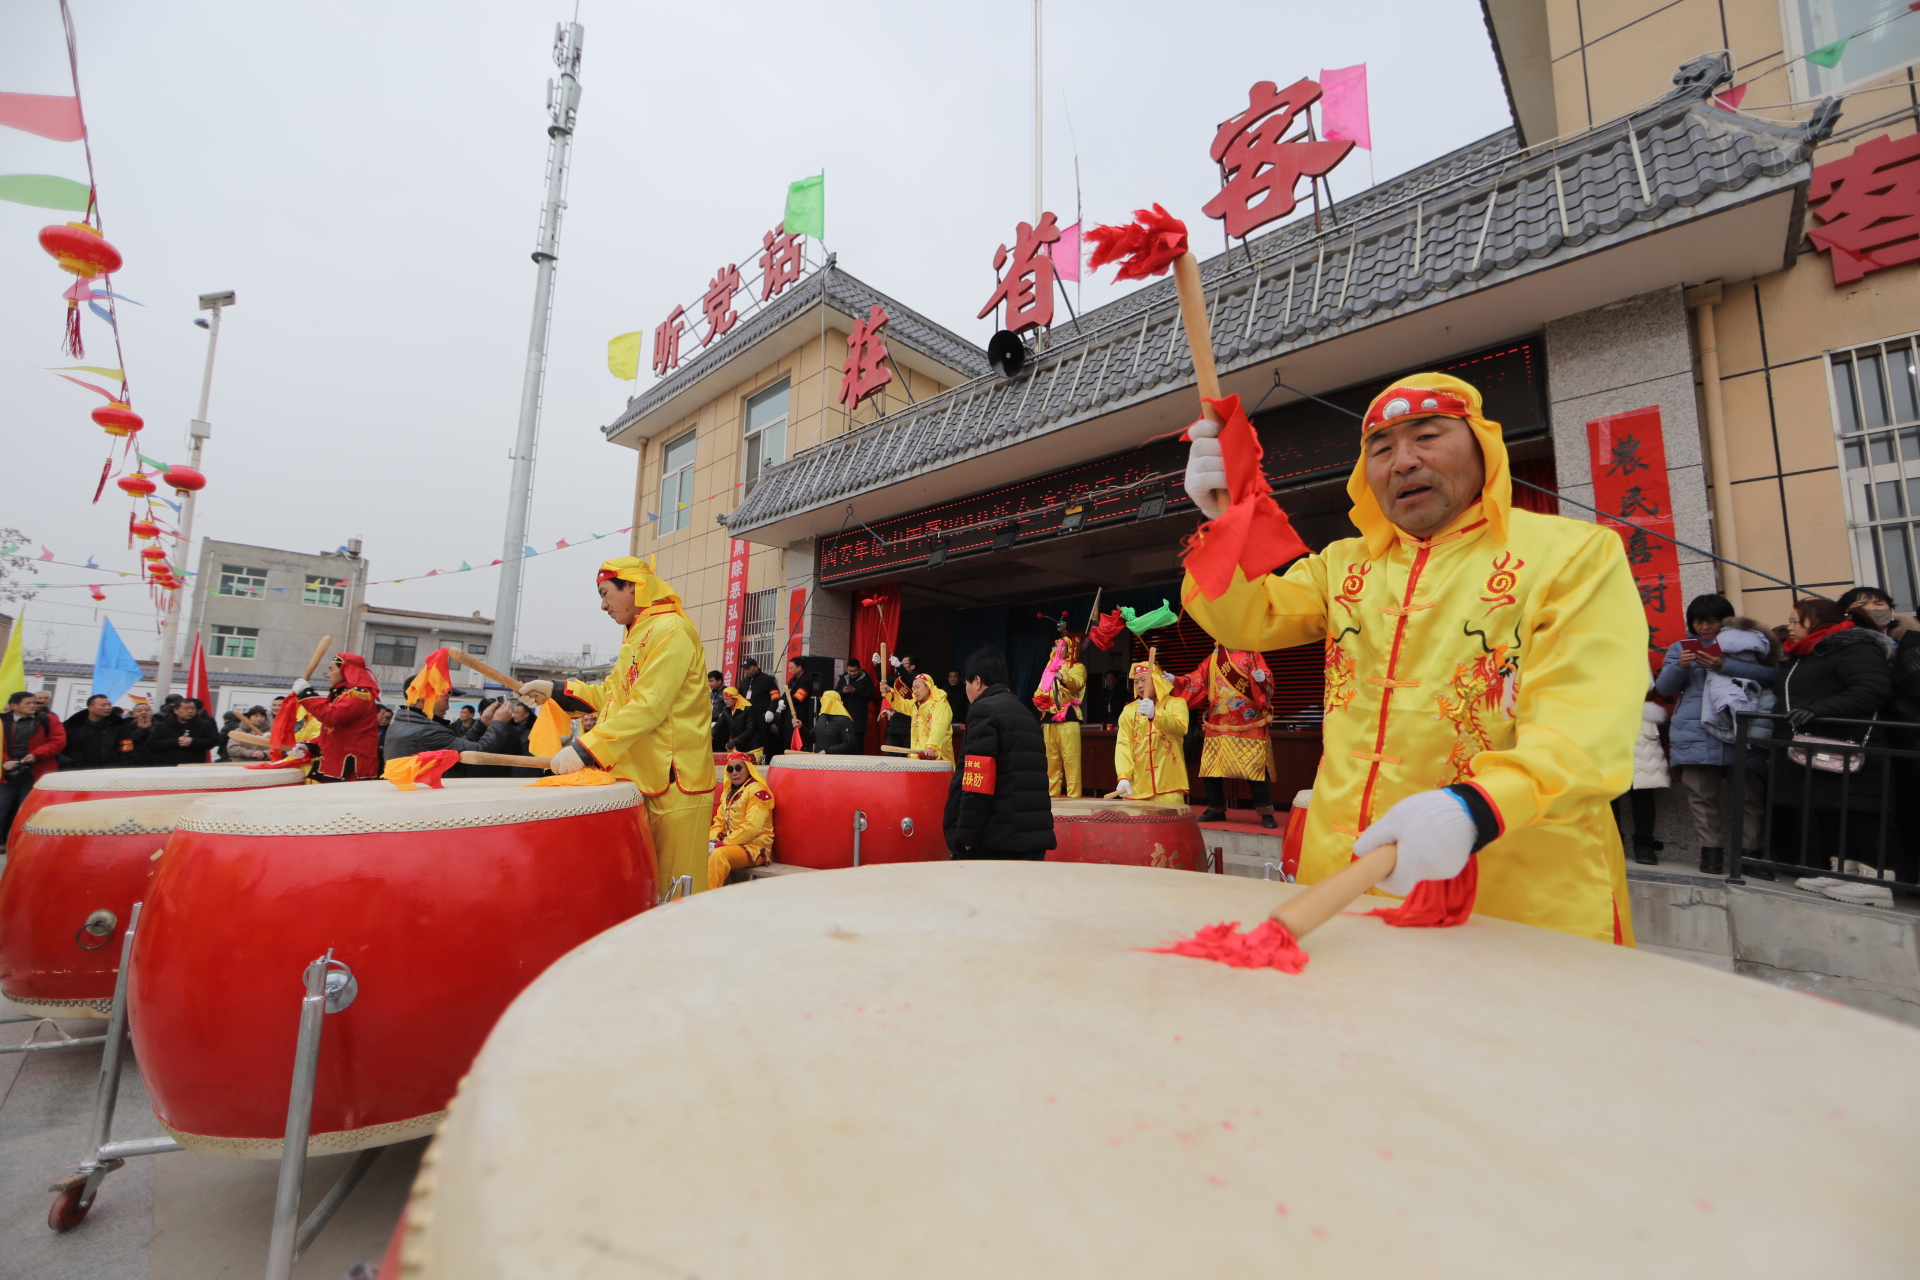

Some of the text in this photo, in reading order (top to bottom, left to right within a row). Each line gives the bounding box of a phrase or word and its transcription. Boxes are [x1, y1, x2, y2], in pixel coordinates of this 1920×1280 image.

[1202, 79, 1356, 239] 客
[652, 220, 804, 376] 听党话
[976, 211, 1061, 335] 省
